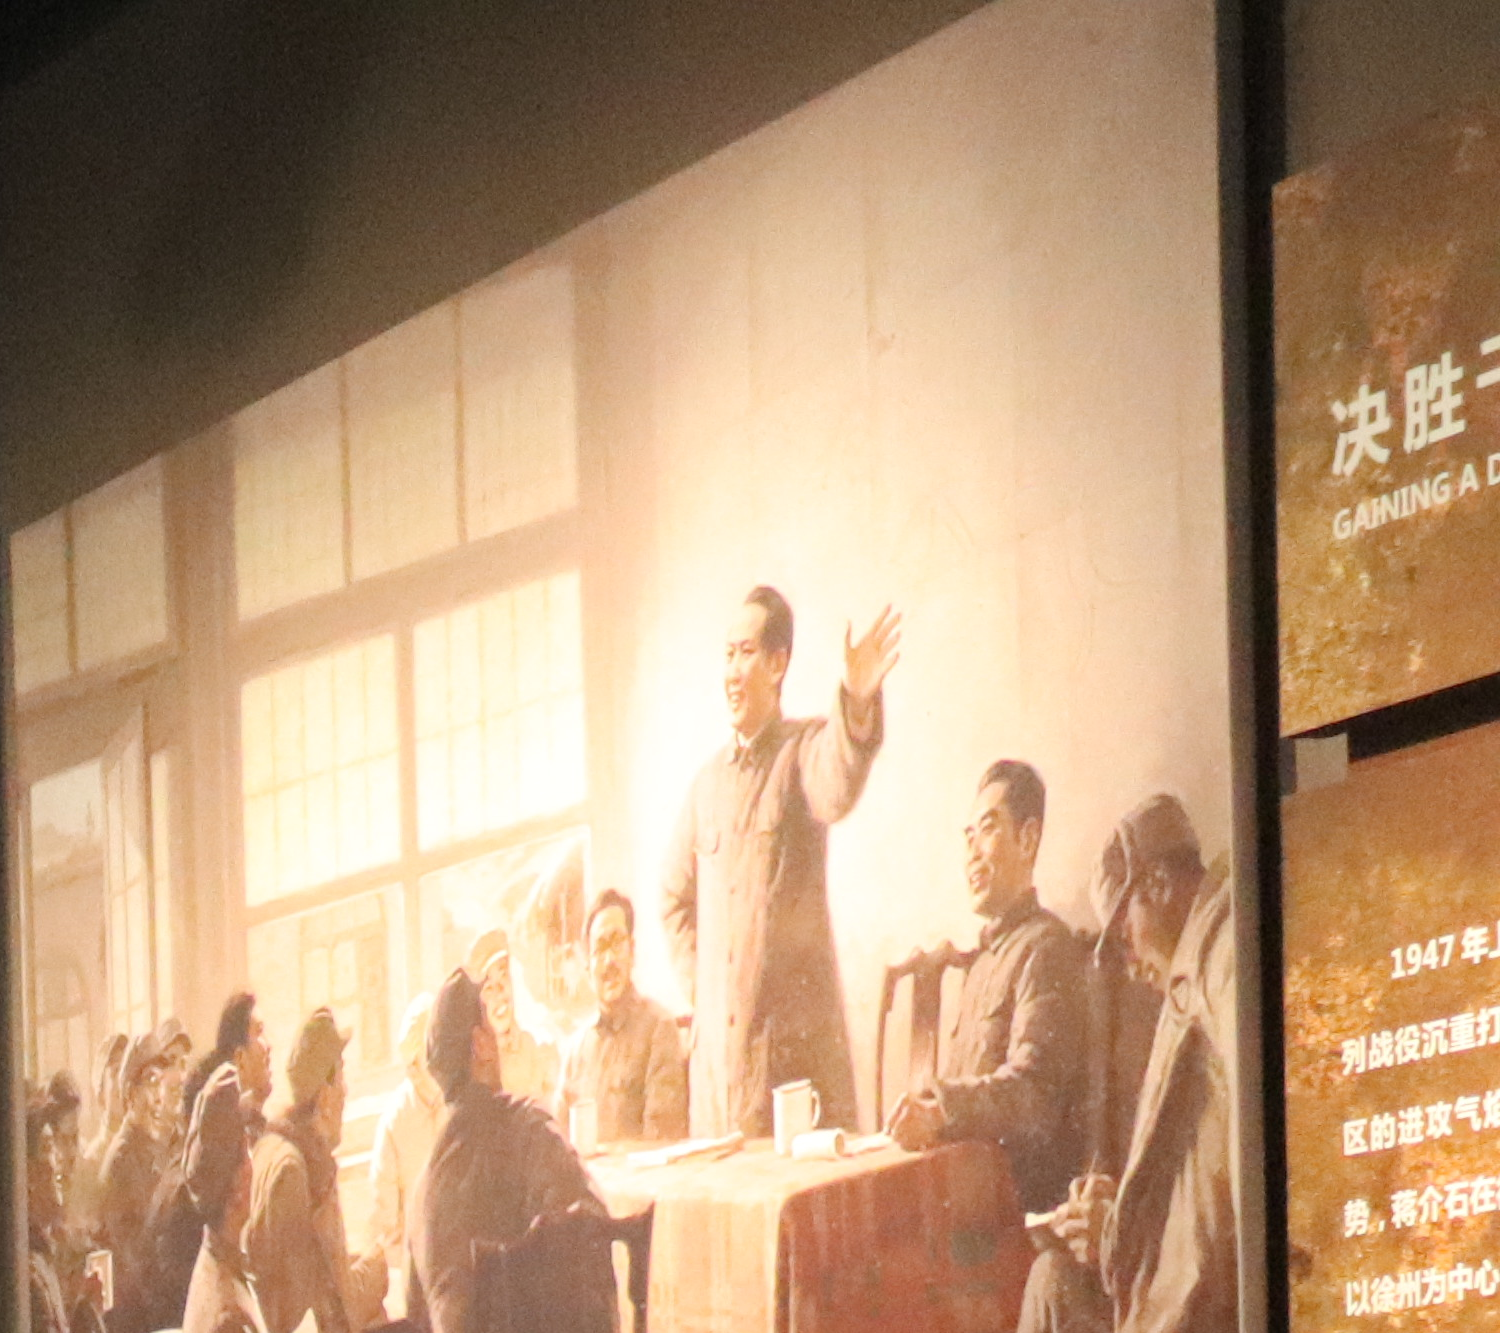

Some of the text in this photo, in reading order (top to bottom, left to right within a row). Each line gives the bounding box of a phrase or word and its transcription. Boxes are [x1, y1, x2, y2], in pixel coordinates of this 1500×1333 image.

[1332, 471, 1452, 541] GAINING
[1457, 462, 1481, 496] A
[1340, 1006, 1500, 1077] 列战役沉重打
[1343, 1176, 1500, 1239] 势，蒋介石在
[1345, 1259, 1500, 1317] 以徐州为中心
